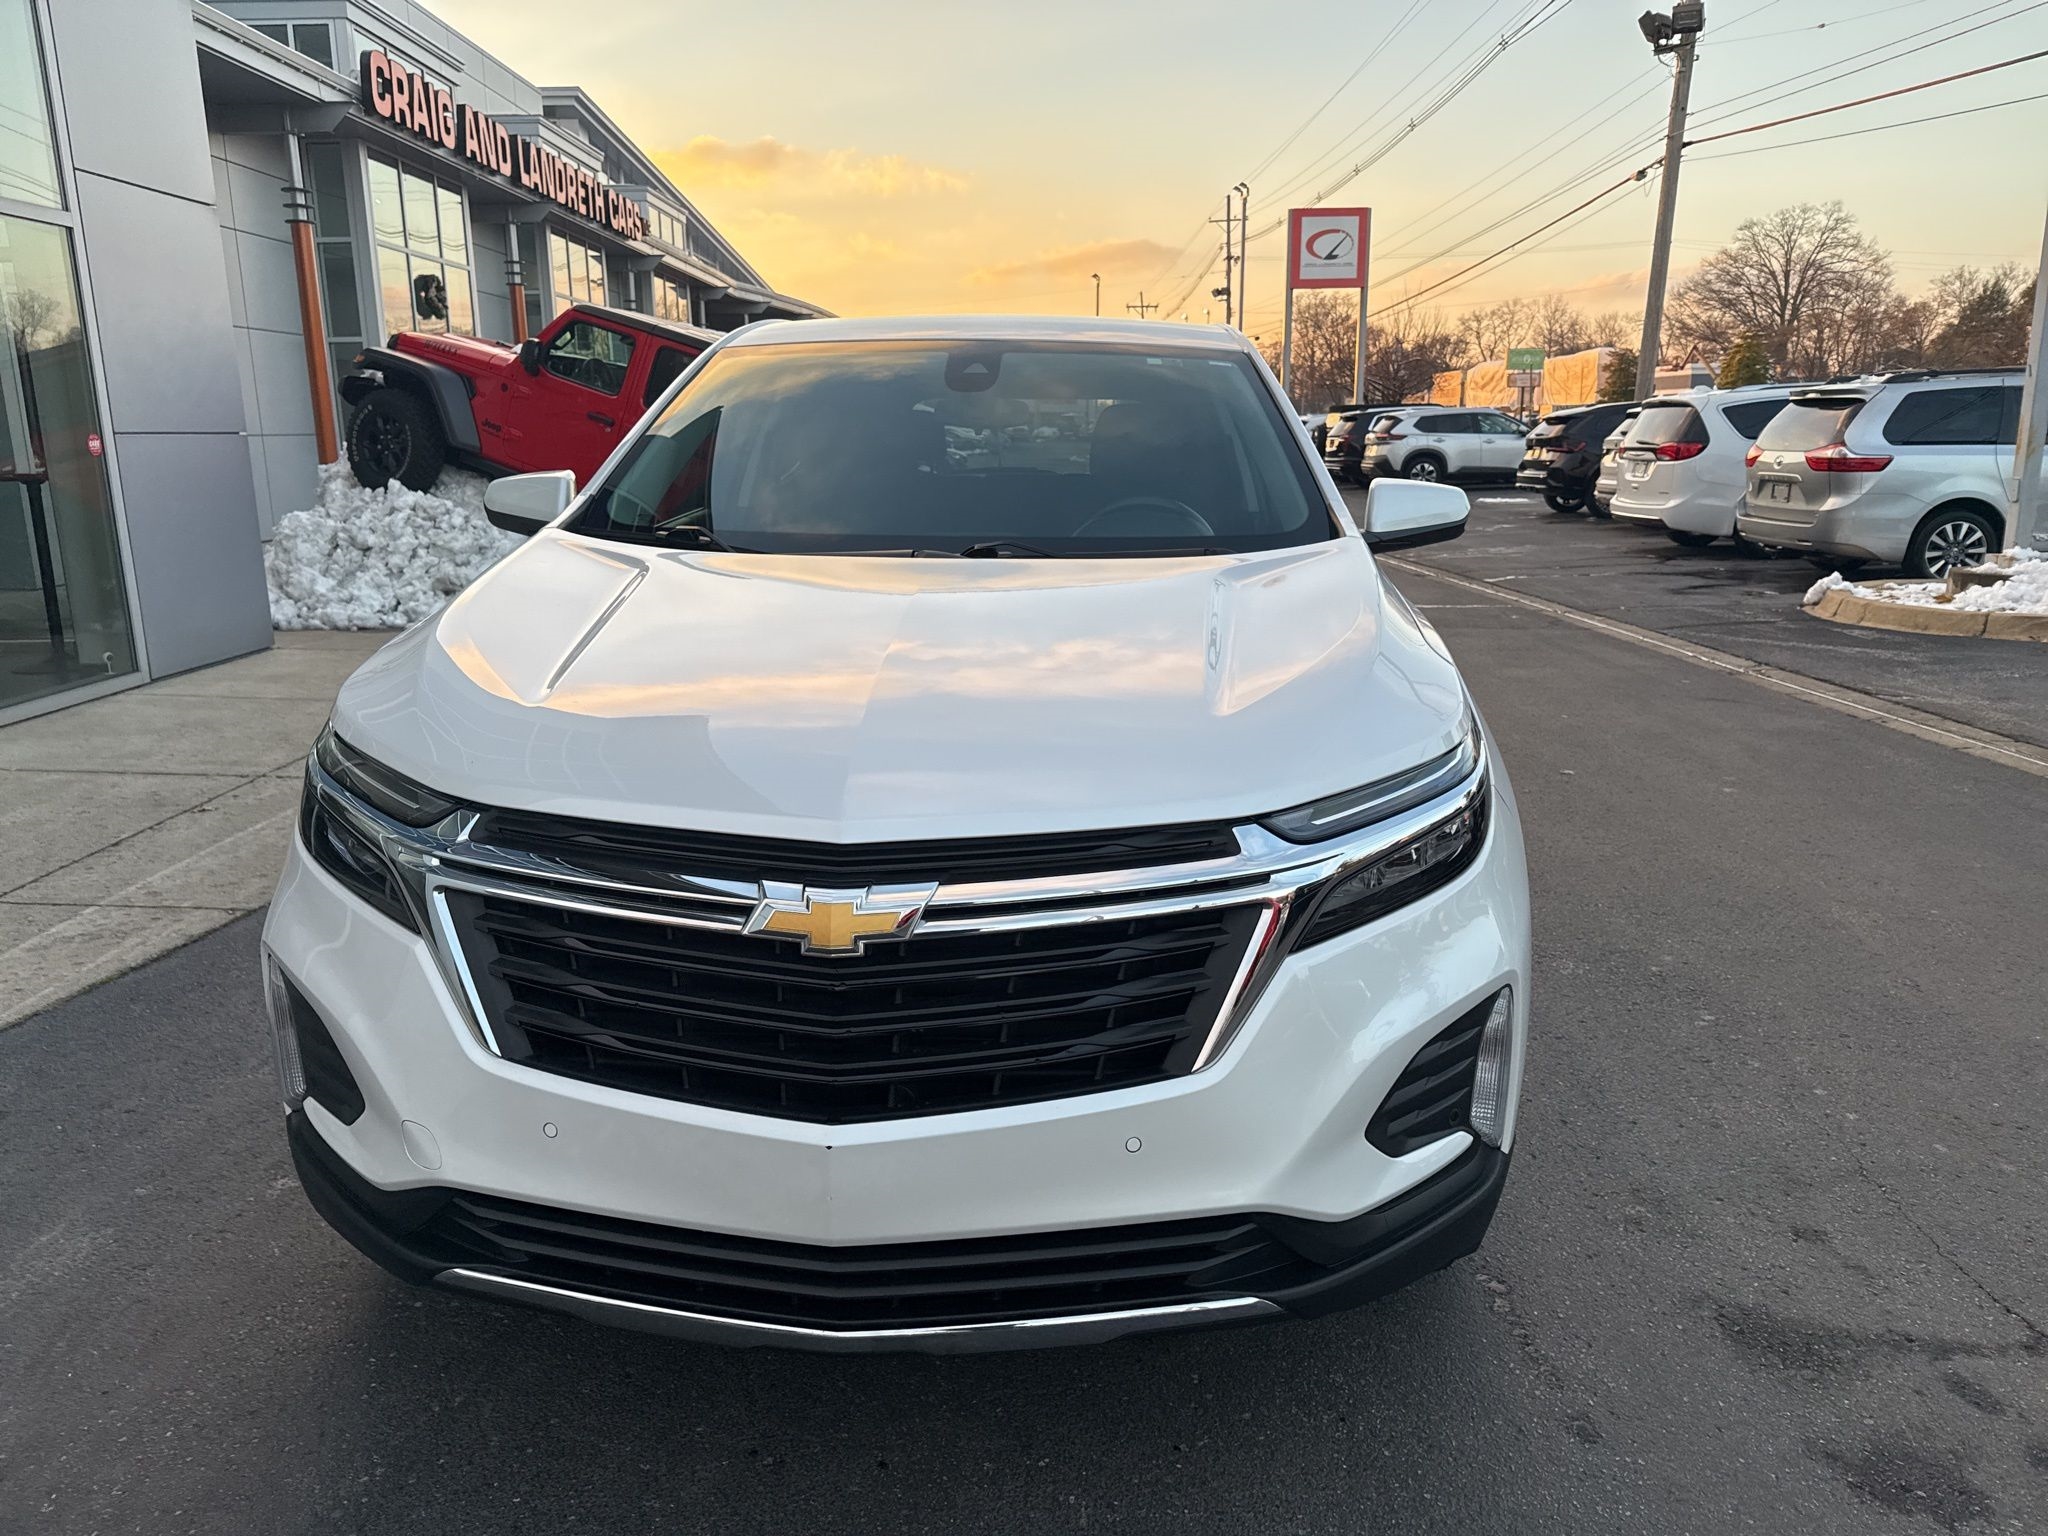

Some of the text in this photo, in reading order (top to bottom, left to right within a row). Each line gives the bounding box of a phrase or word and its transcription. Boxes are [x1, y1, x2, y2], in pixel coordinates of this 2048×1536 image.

[364, 49, 644, 242] CRAIG AND LANDRETH CARS
[481, 417, 502, 433] Jeep
